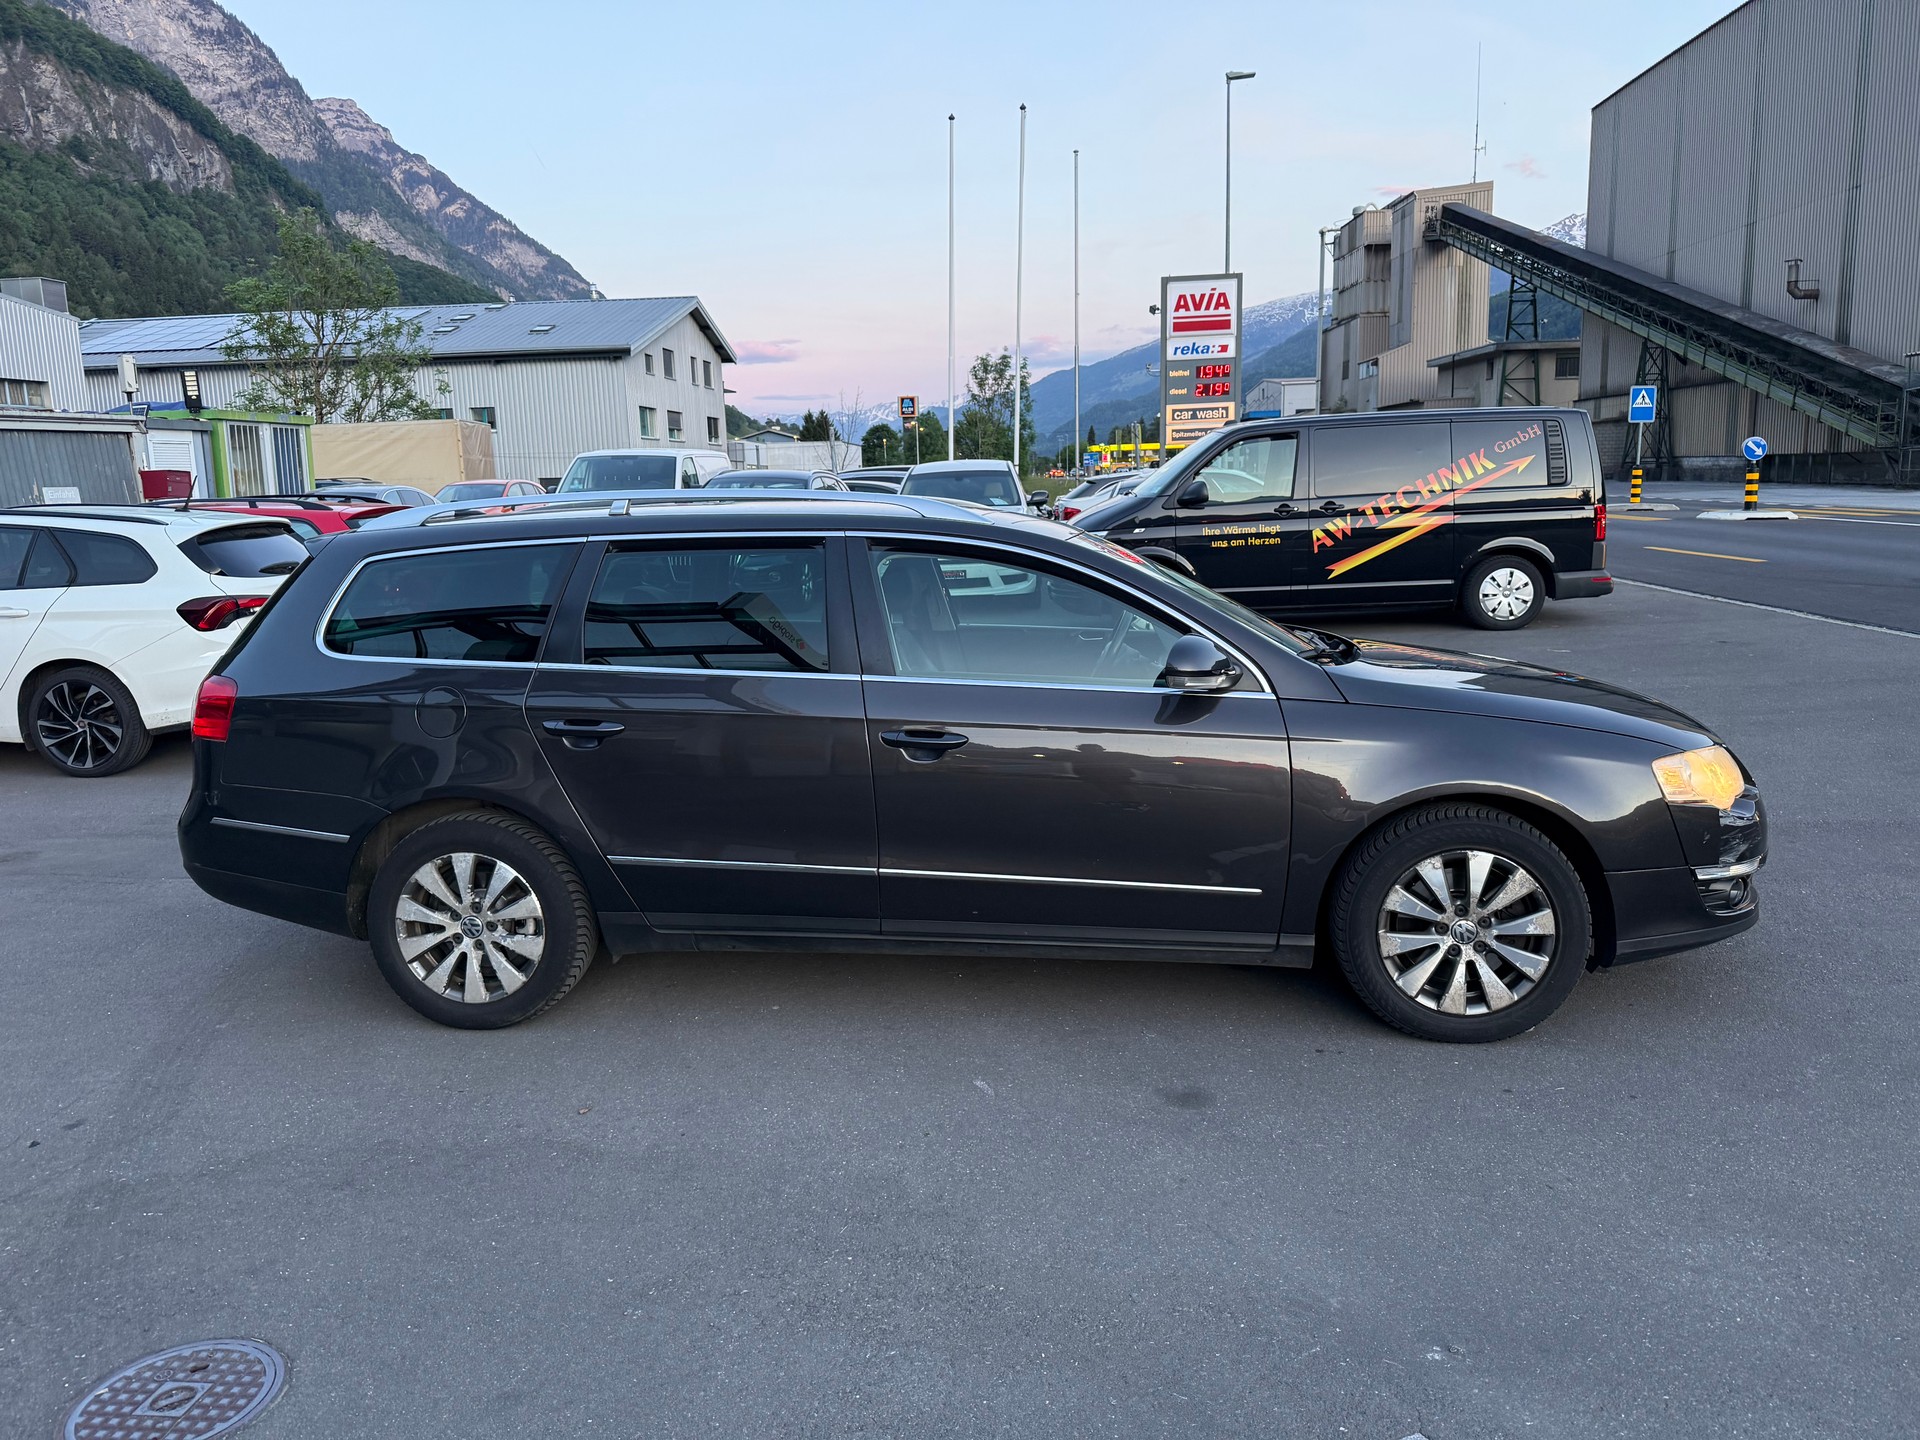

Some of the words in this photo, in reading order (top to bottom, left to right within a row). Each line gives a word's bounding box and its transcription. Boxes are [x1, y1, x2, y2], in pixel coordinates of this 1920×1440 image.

[1169, 387, 1188, 395] diesel
[1174, 410, 1193, 420] car
[1196, 407, 1227, 419] wash
[1312, 448, 1496, 553] AW-TECHNIK
[1493, 423, 1542, 454] GmbH
[1202, 527, 1221, 536] Ihre
[1222, 525, 1257, 535] Wärme
[1259, 523, 1281, 535] liegt
[1211, 540, 1229, 548] uns
[1230, 539, 1245, 547] am
[1248, 536, 1281, 547] Herzen
